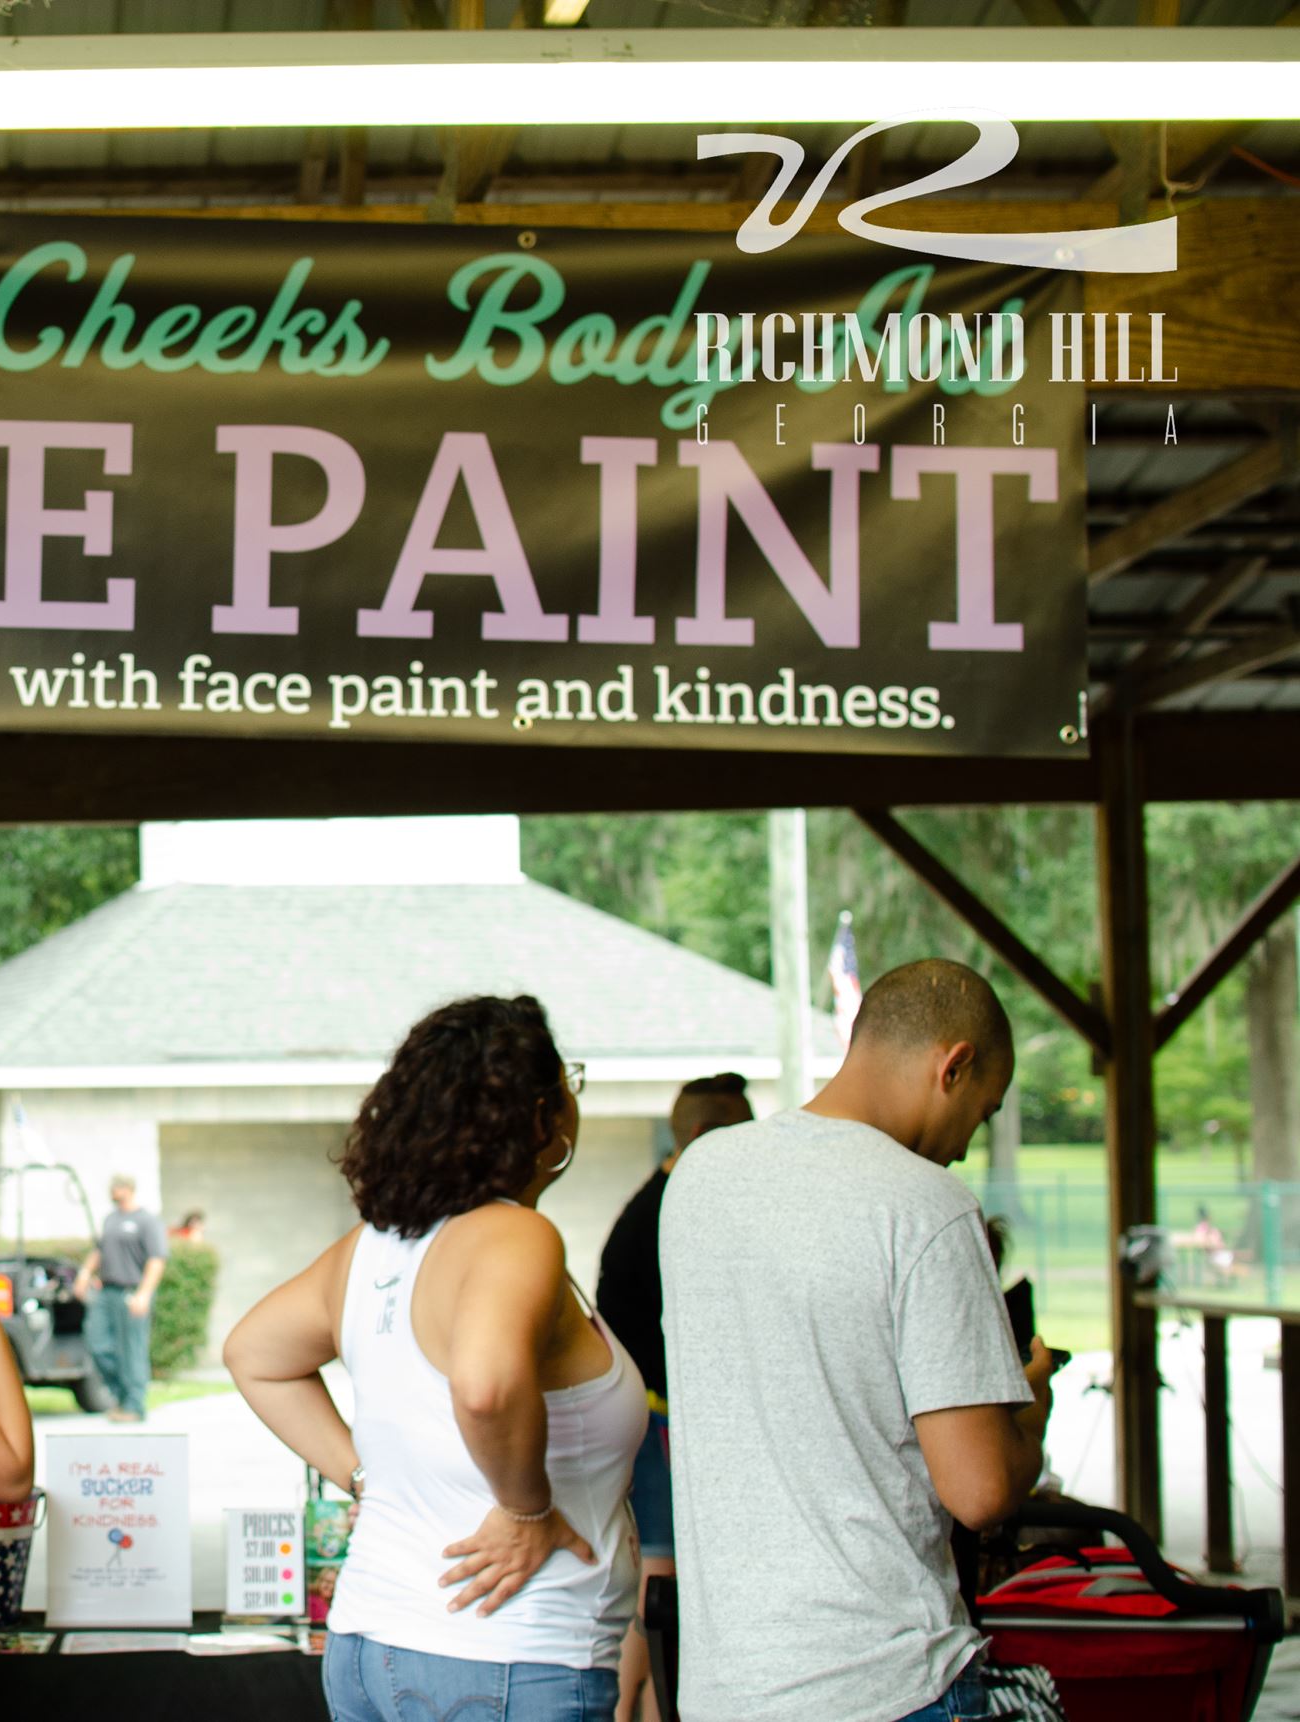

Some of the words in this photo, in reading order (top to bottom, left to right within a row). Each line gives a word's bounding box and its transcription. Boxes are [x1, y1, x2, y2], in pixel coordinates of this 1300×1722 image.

[425, 253, 761, 430] Body
[212, 424, 1059, 652] PAINT
[10, 652, 160, 711] with
[178, 654, 312, 715] face
[329, 660, 499, 729] paint
[515, 665, 636, 728] and
[653, 664, 956, 730] kindness.
[242, 1512, 295, 1538] PRICES
